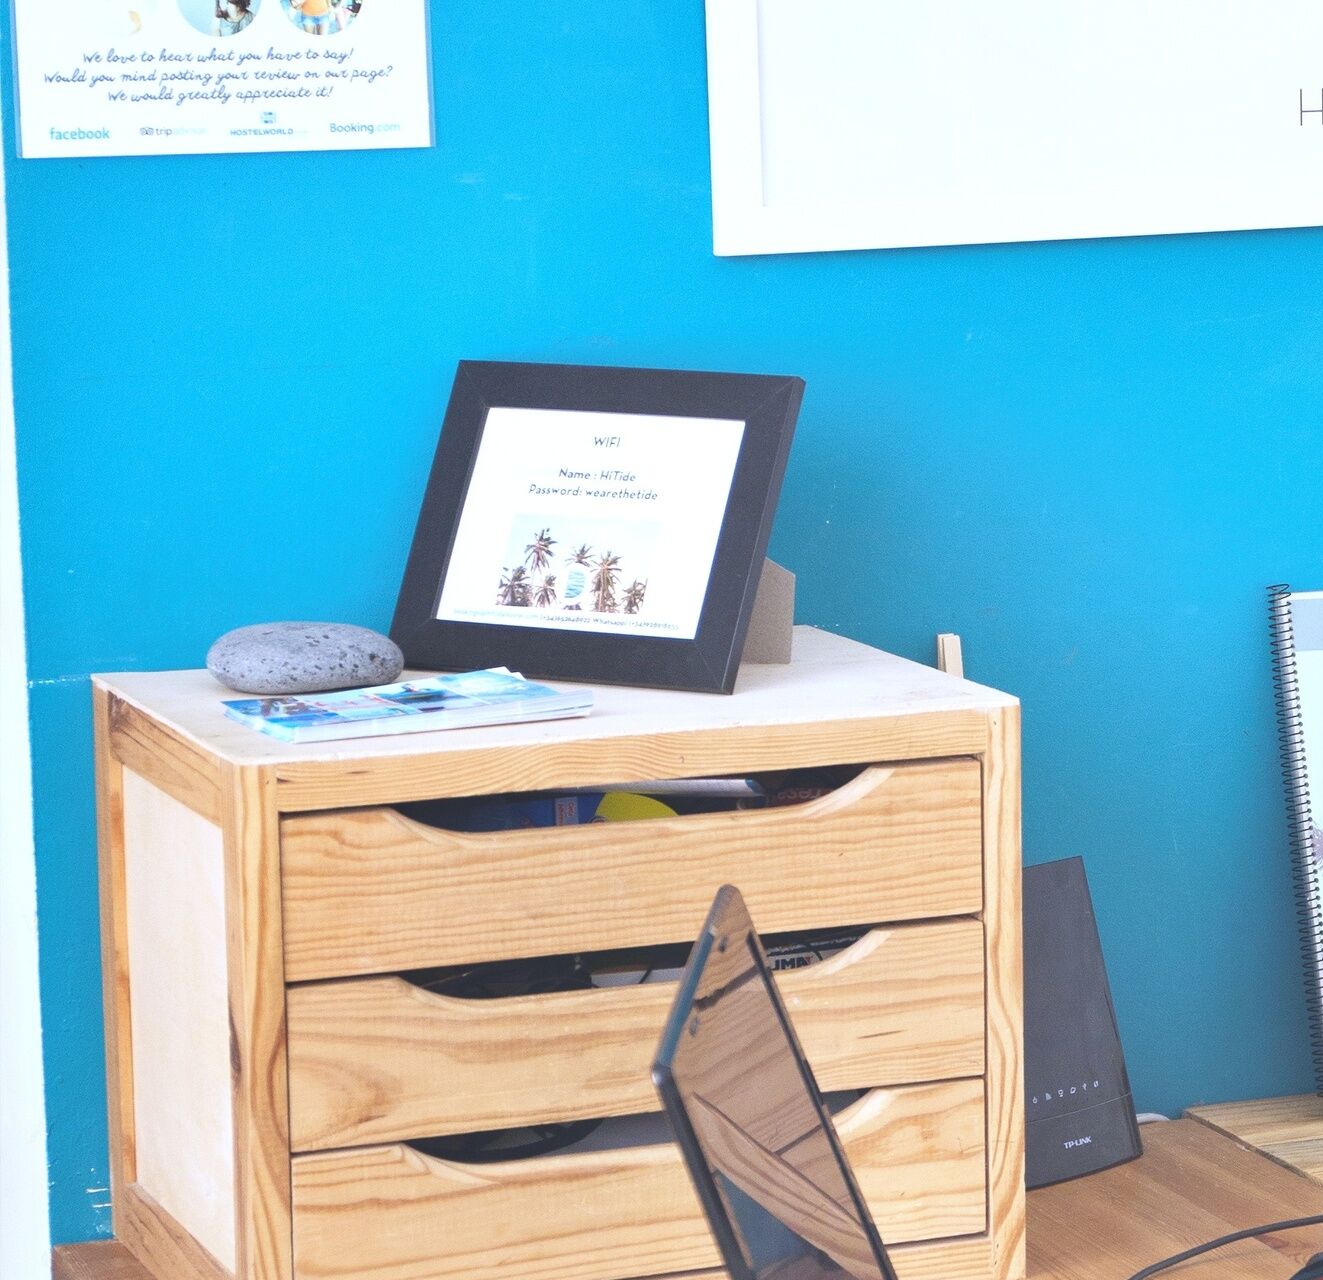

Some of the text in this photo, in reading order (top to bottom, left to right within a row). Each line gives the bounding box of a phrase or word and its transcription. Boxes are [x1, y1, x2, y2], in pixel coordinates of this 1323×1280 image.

[83, 46, 354, 66] We love to hear what you have to say!
[44, 65, 393, 88] Would you mind posting your review on our page?
[108, 85, 333, 106] We would greatly appreciate it!
[49, 127, 110, 140] facebook
[329, 122, 400, 134] Booking.com
[593, 436, 621, 448] WIFI
[559, 468, 590, 480] Name
[600, 469, 636, 483] HiTide
[528, 484, 658, 501] Password: wearethetide
[1063, 1135, 1092, 1150] TP-LINK
